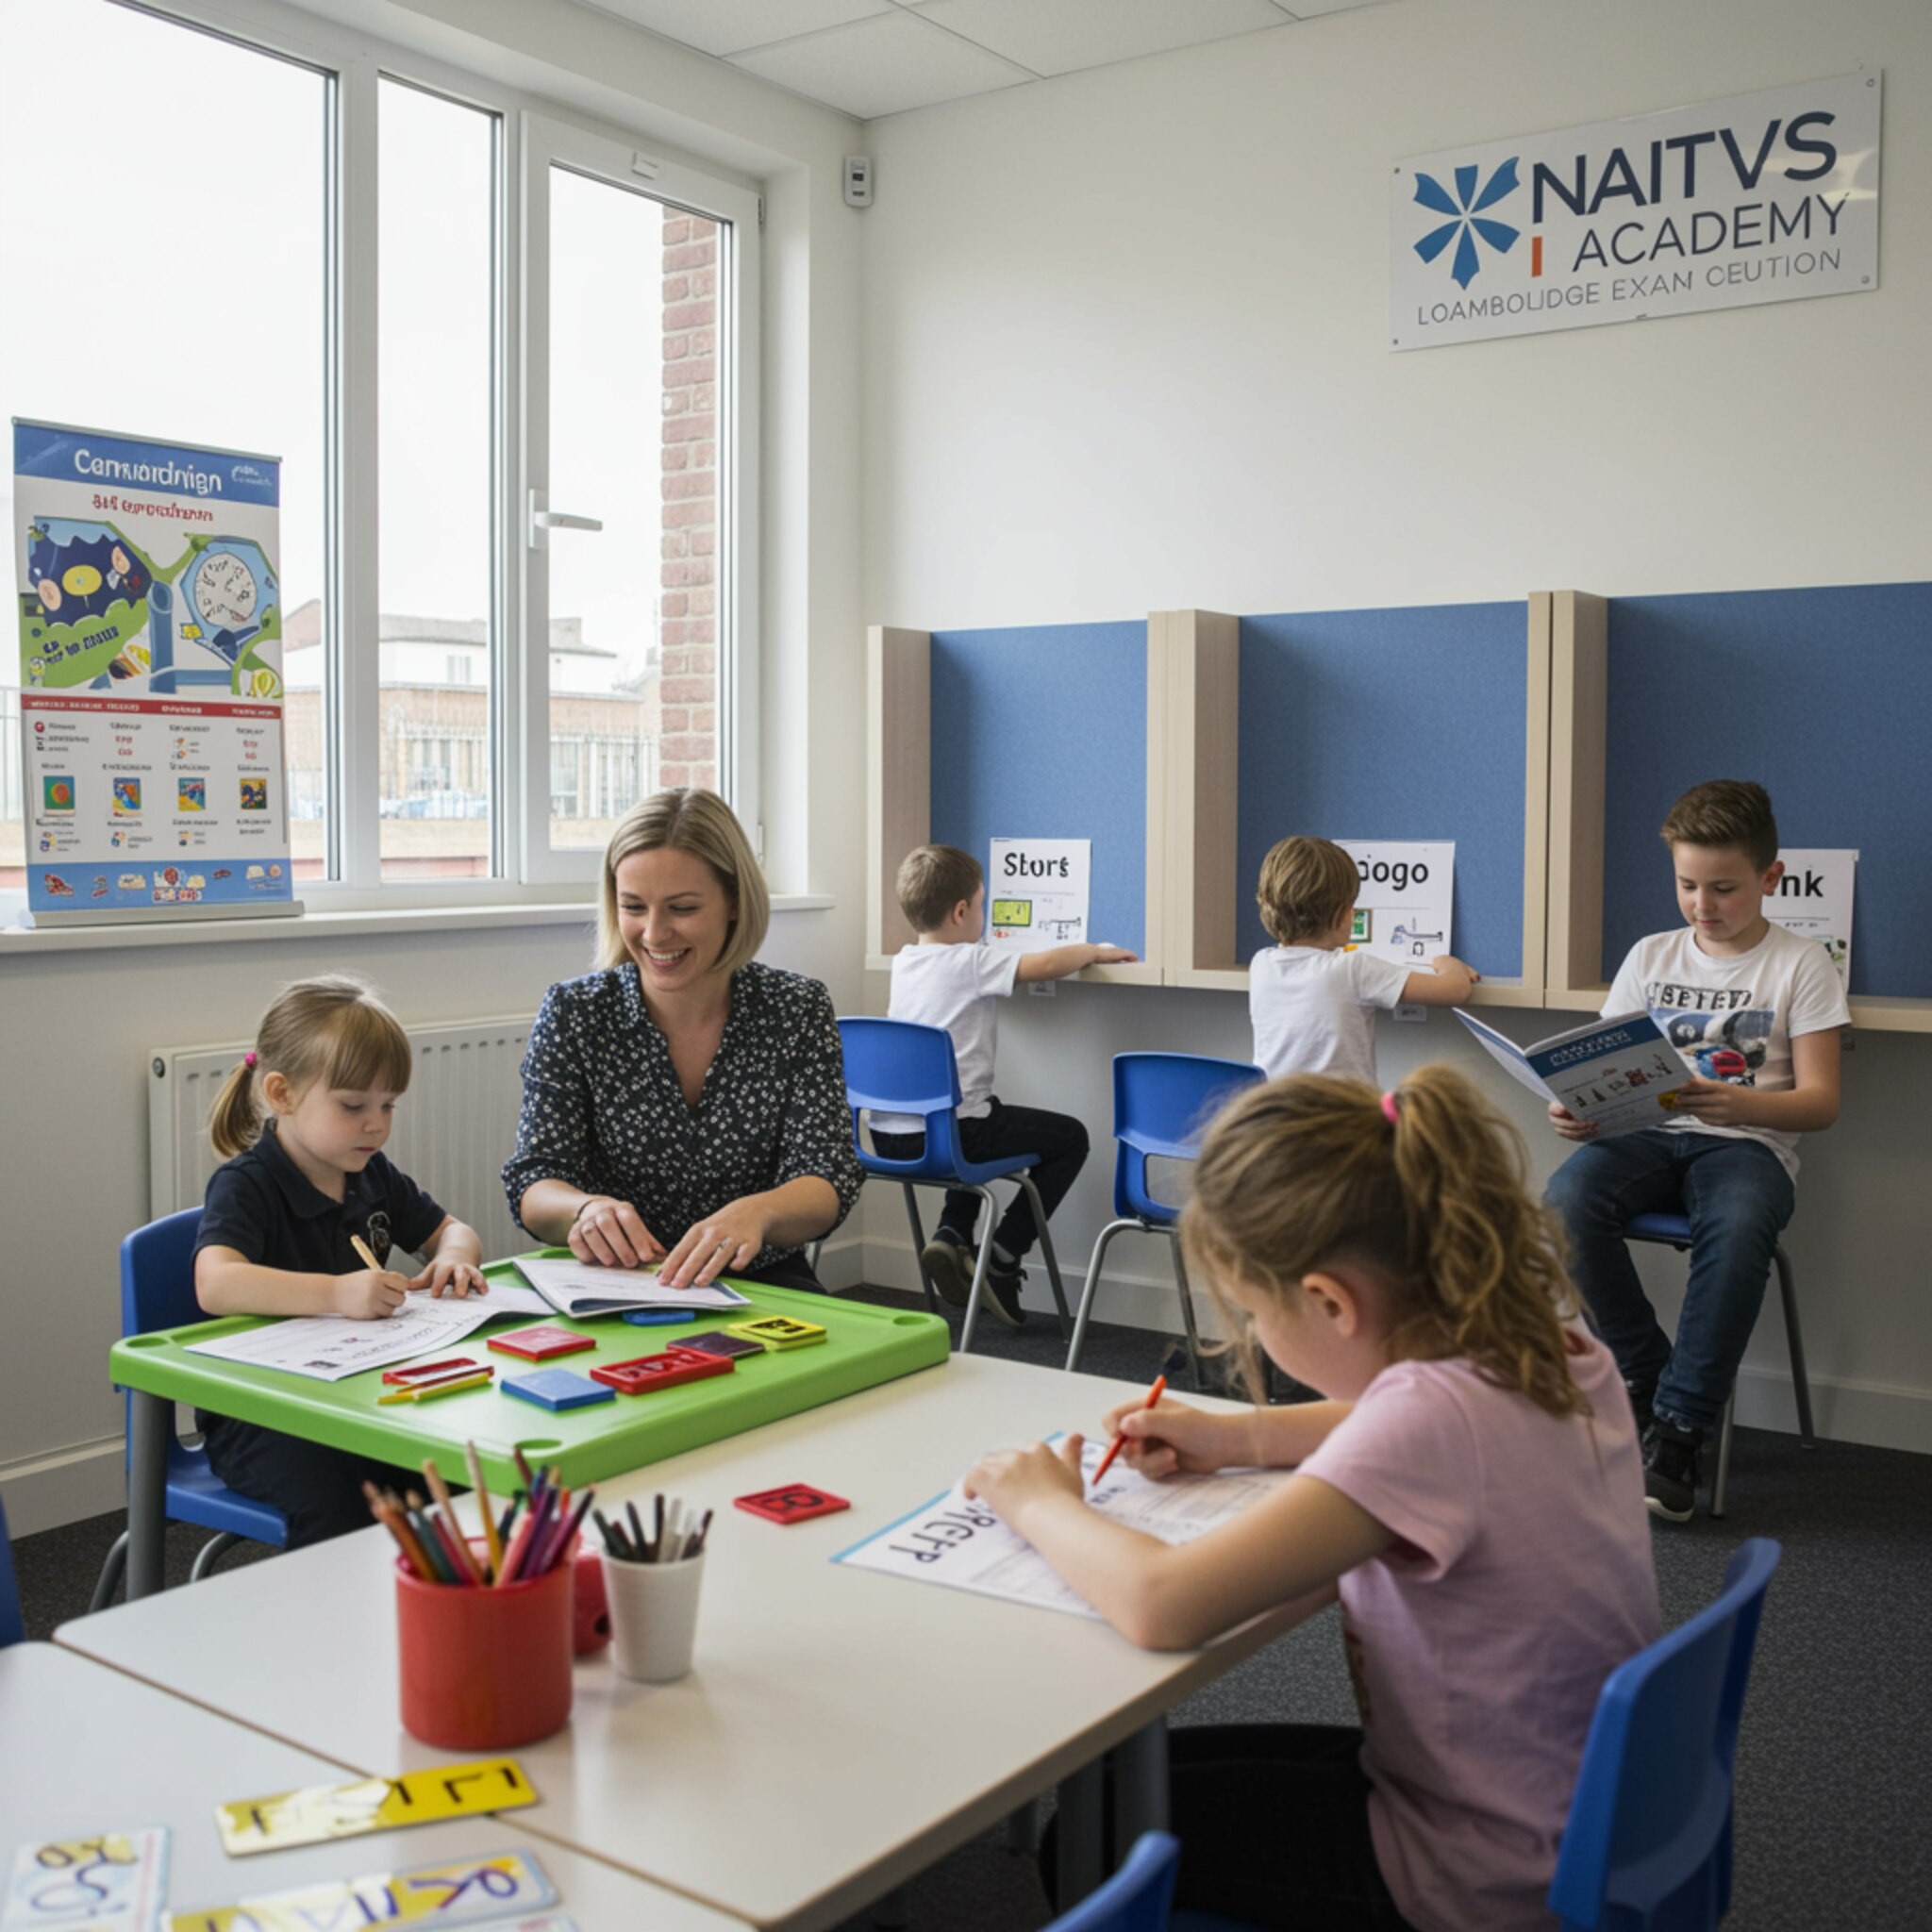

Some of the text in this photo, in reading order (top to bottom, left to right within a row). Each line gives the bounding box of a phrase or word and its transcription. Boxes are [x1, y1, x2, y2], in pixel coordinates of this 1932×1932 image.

[1531, 110, 1838, 225] NAITVS
[1572, 192, 1851, 273] ACADEMY
[1706, 248, 1841, 288] CEUTION
